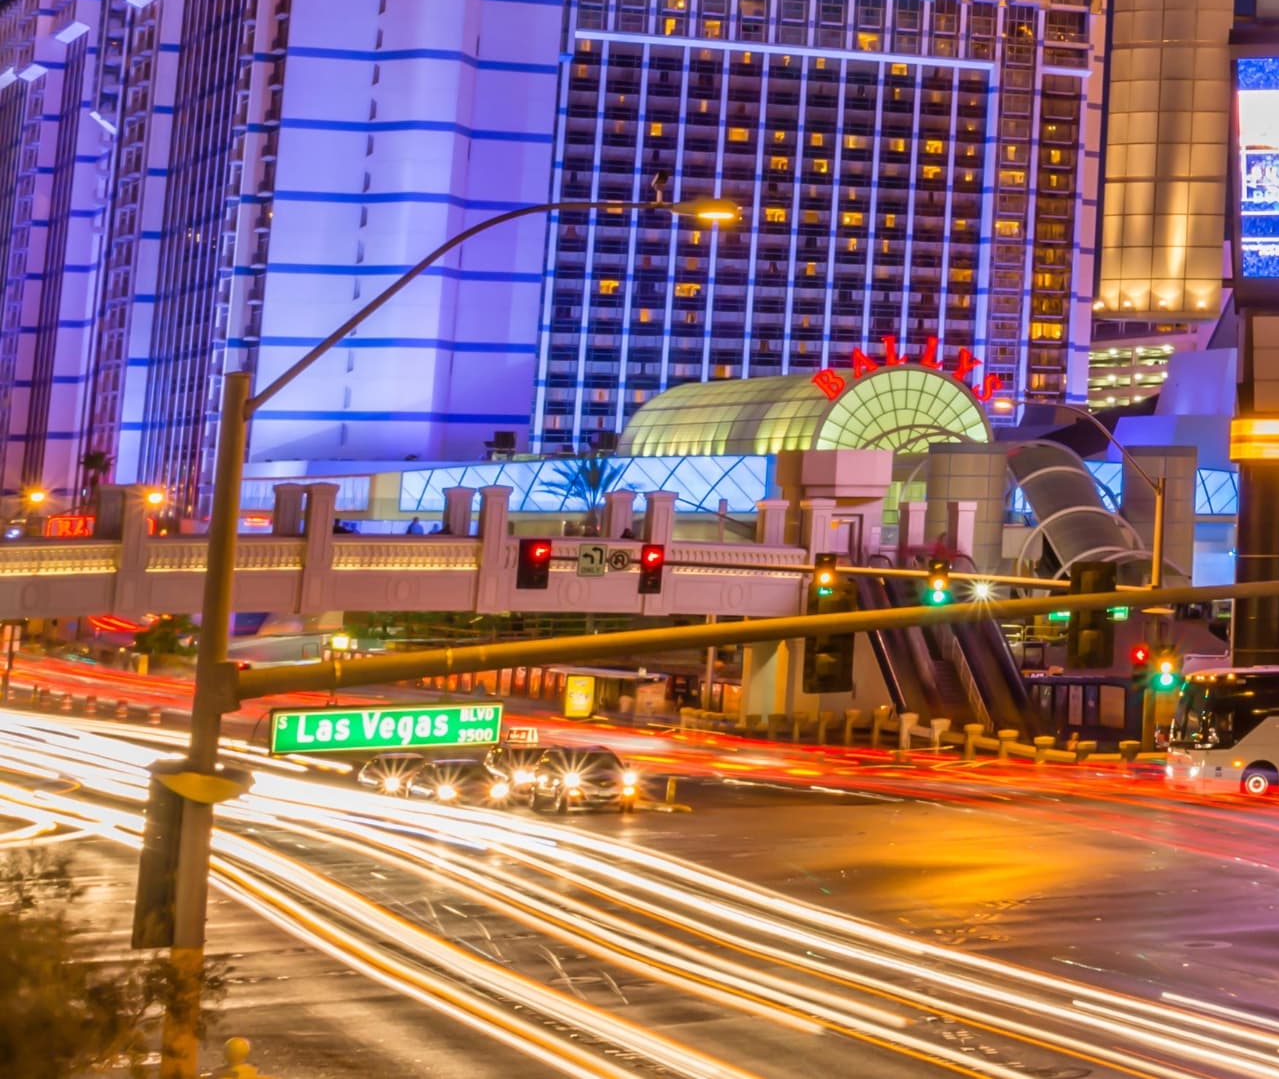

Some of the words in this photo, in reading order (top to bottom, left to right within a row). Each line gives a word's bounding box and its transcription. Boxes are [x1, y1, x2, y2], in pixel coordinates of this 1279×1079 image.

[811, 335, 1003, 401] BALLYS
[278, 716, 288, 729] S
[297, 715, 350, 743] Las
[361, 711, 448, 745] Vegas
[459, 708, 494, 722] BLVD
[457, 728, 493, 743] 3500
